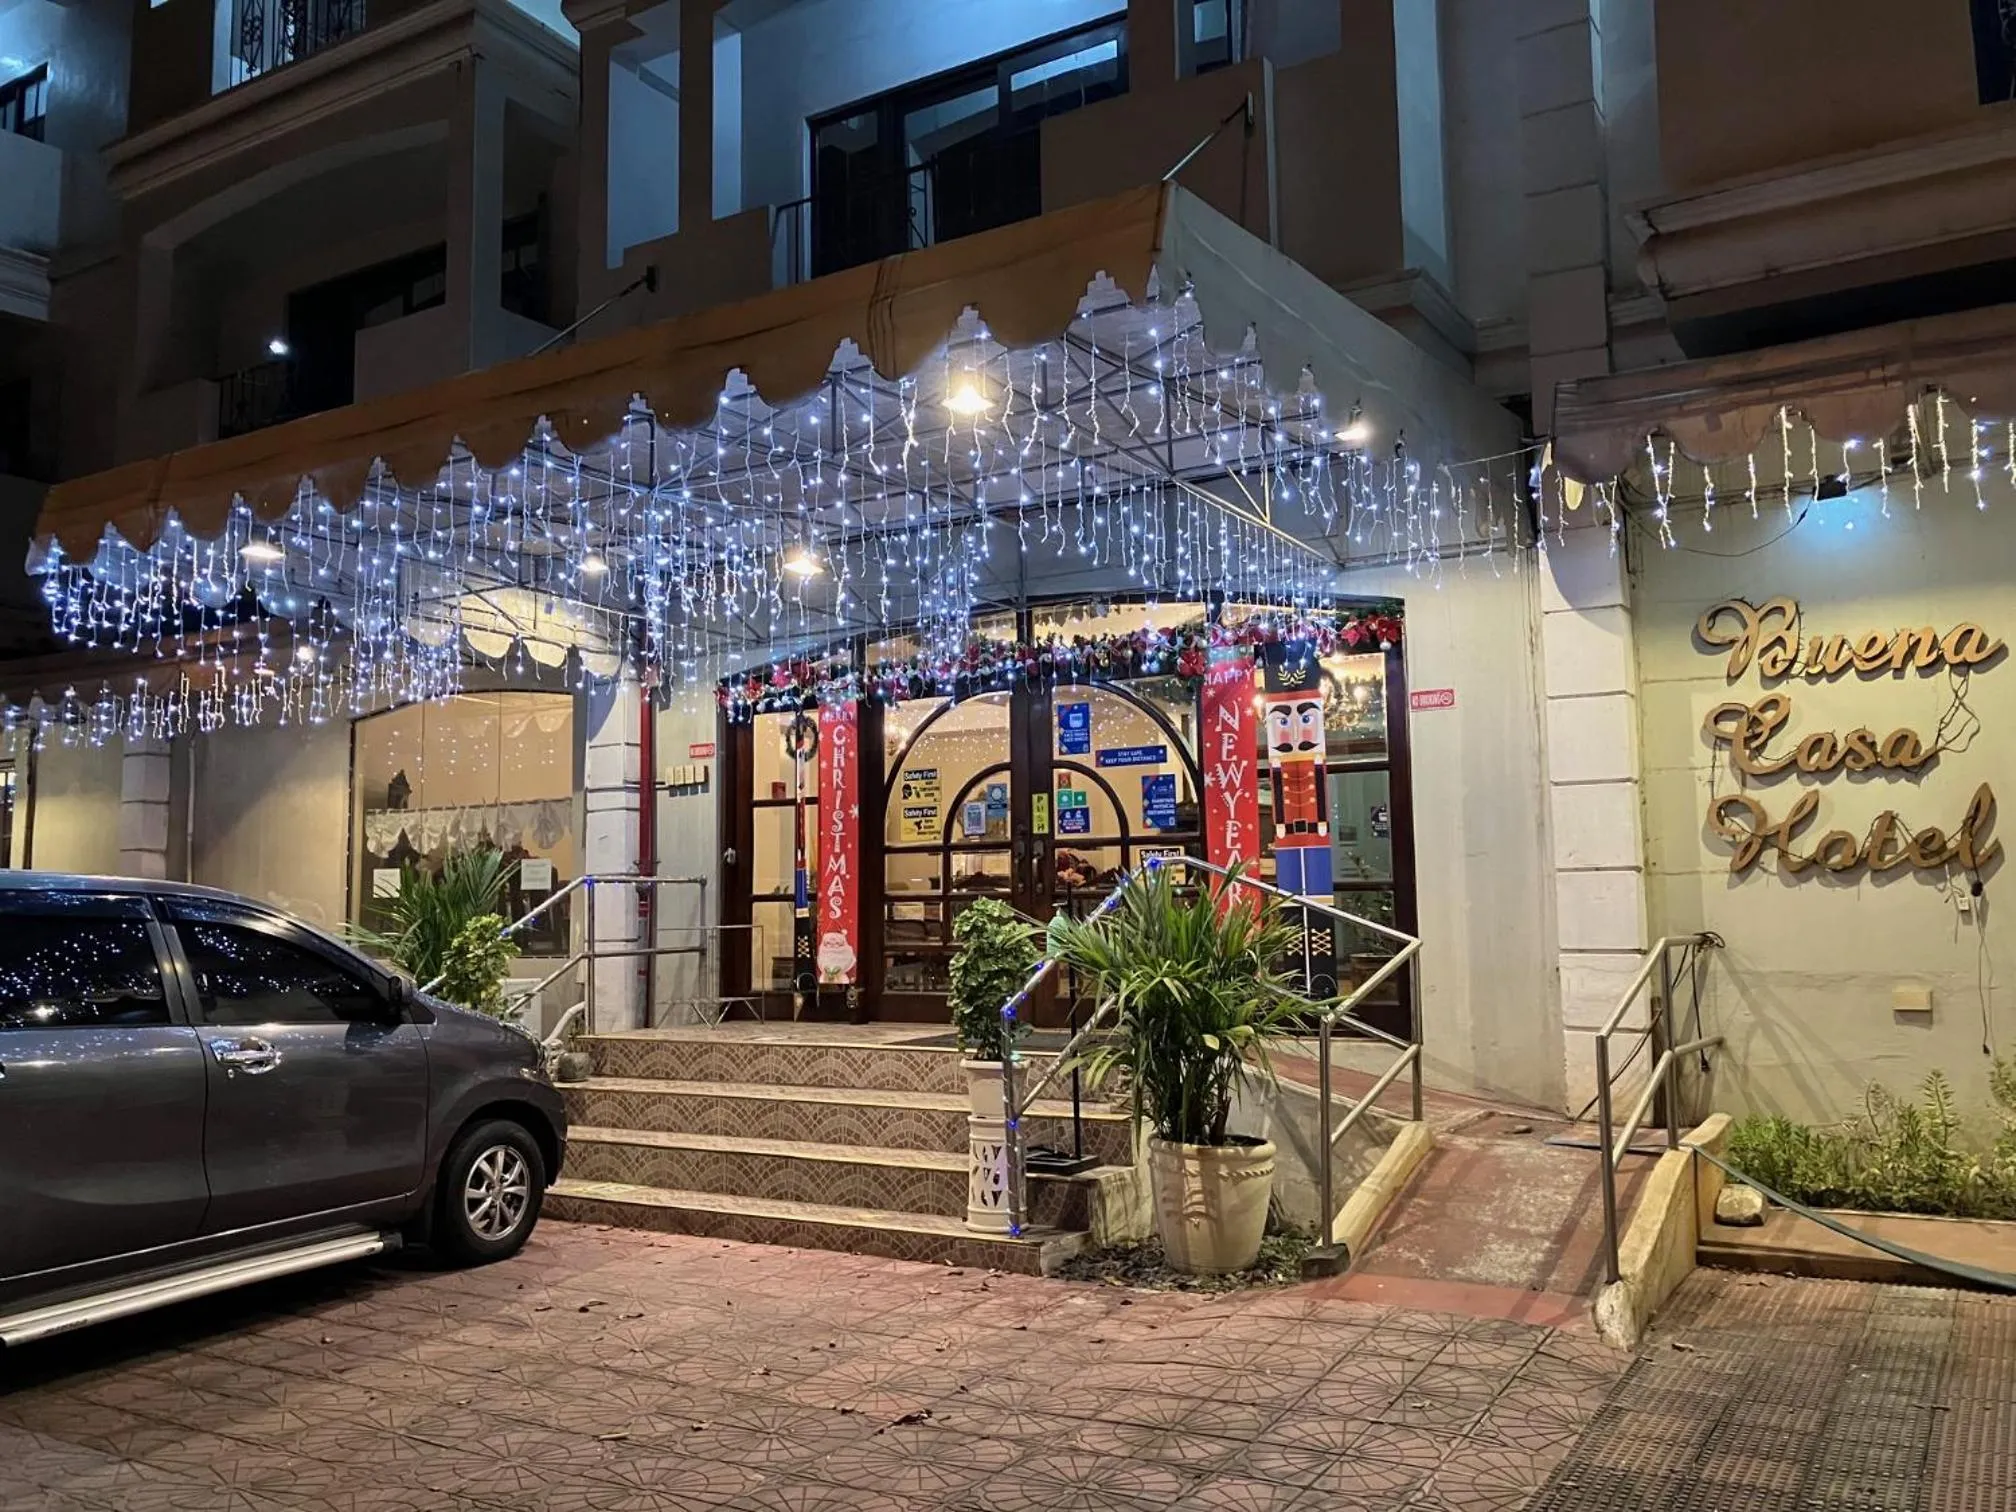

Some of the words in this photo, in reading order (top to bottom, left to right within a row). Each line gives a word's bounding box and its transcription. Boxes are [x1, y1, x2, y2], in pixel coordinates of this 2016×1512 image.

[1203, 668, 1254, 686] HAPPY
[1698, 596, 2003, 679] Buena
[1704, 693, 1937, 775] Casa
[825, 724, 846, 919] CHRISTMAS
[1036, 795, 1045, 831] PUSH
[1707, 782, 2002, 872] Hotel
